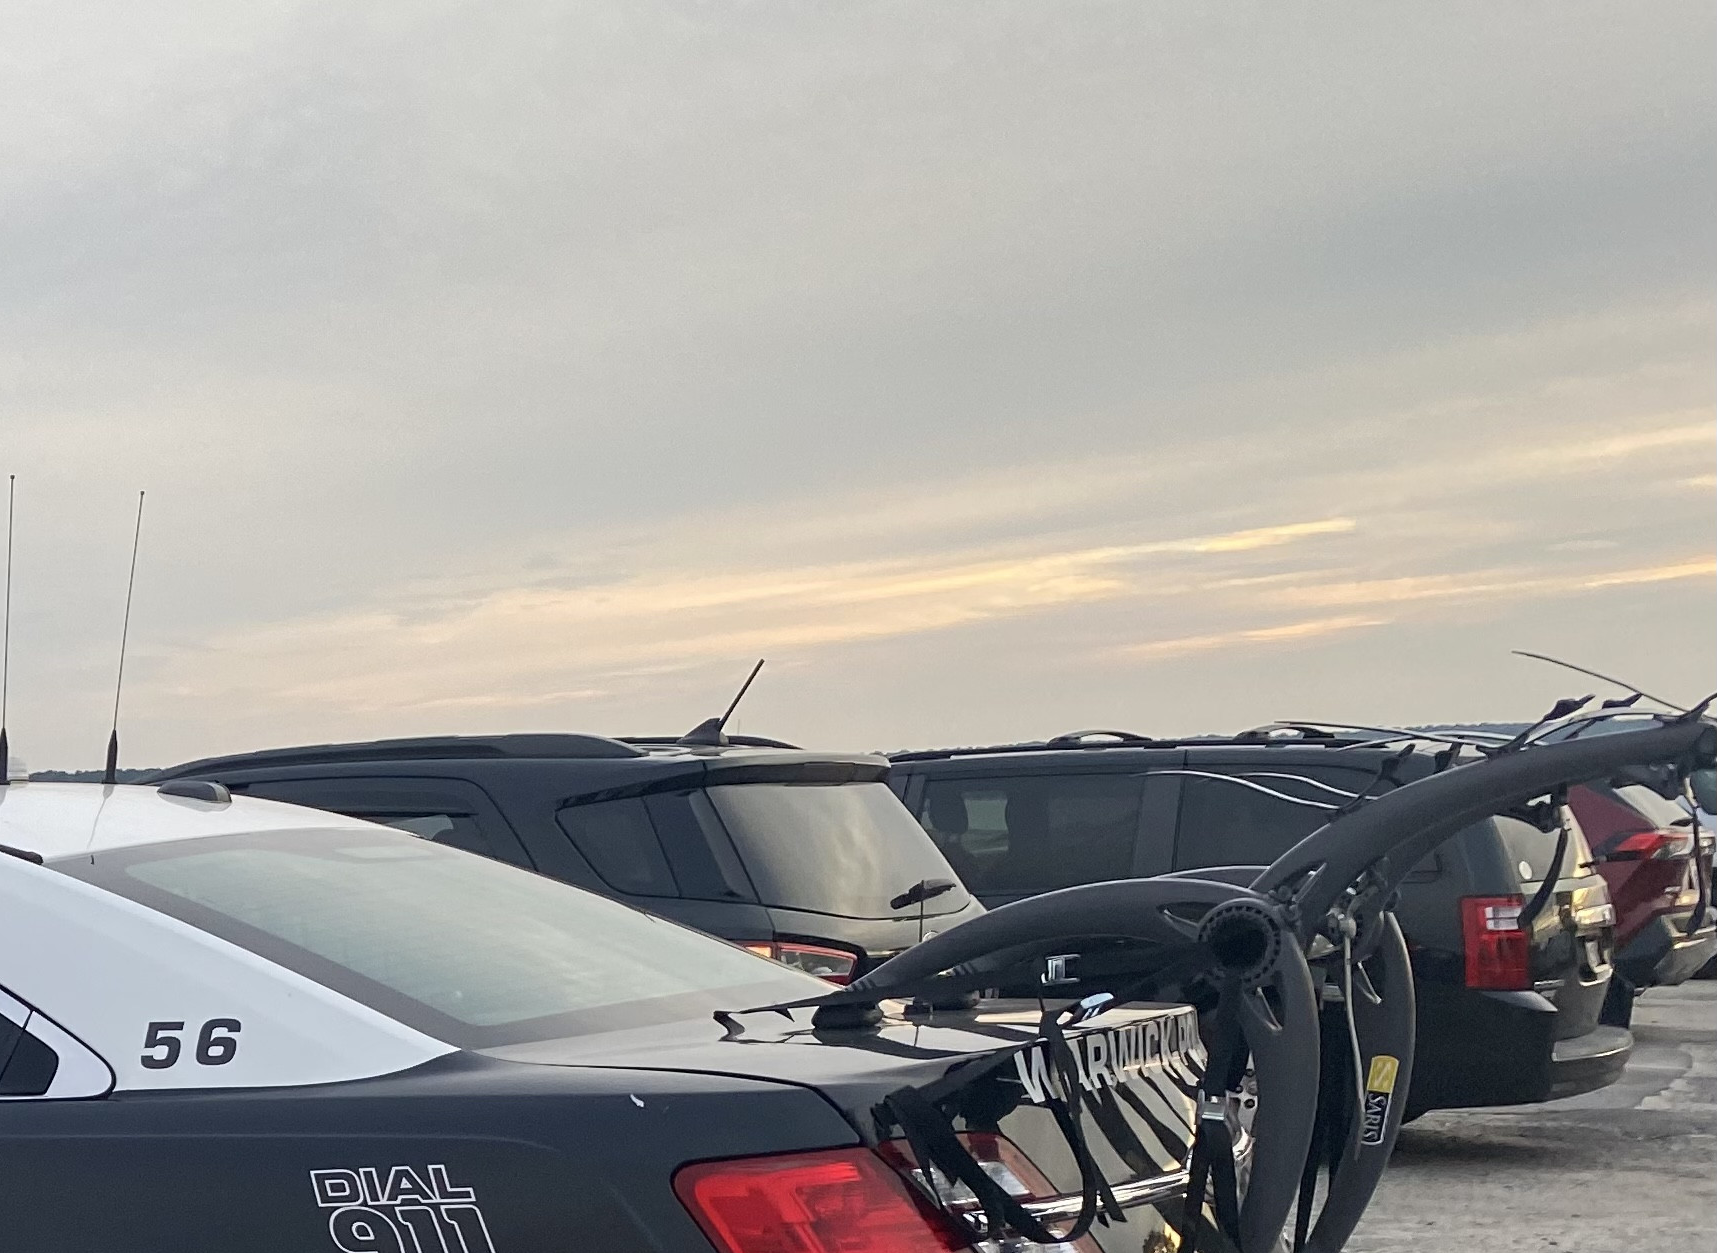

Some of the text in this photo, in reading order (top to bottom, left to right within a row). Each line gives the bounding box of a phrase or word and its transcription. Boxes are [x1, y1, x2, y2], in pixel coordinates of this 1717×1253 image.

[140, 1018, 242, 1069] 56
[1364, 1093, 1387, 1140] SARIS
[309, 1164, 477, 1208] DIAL
